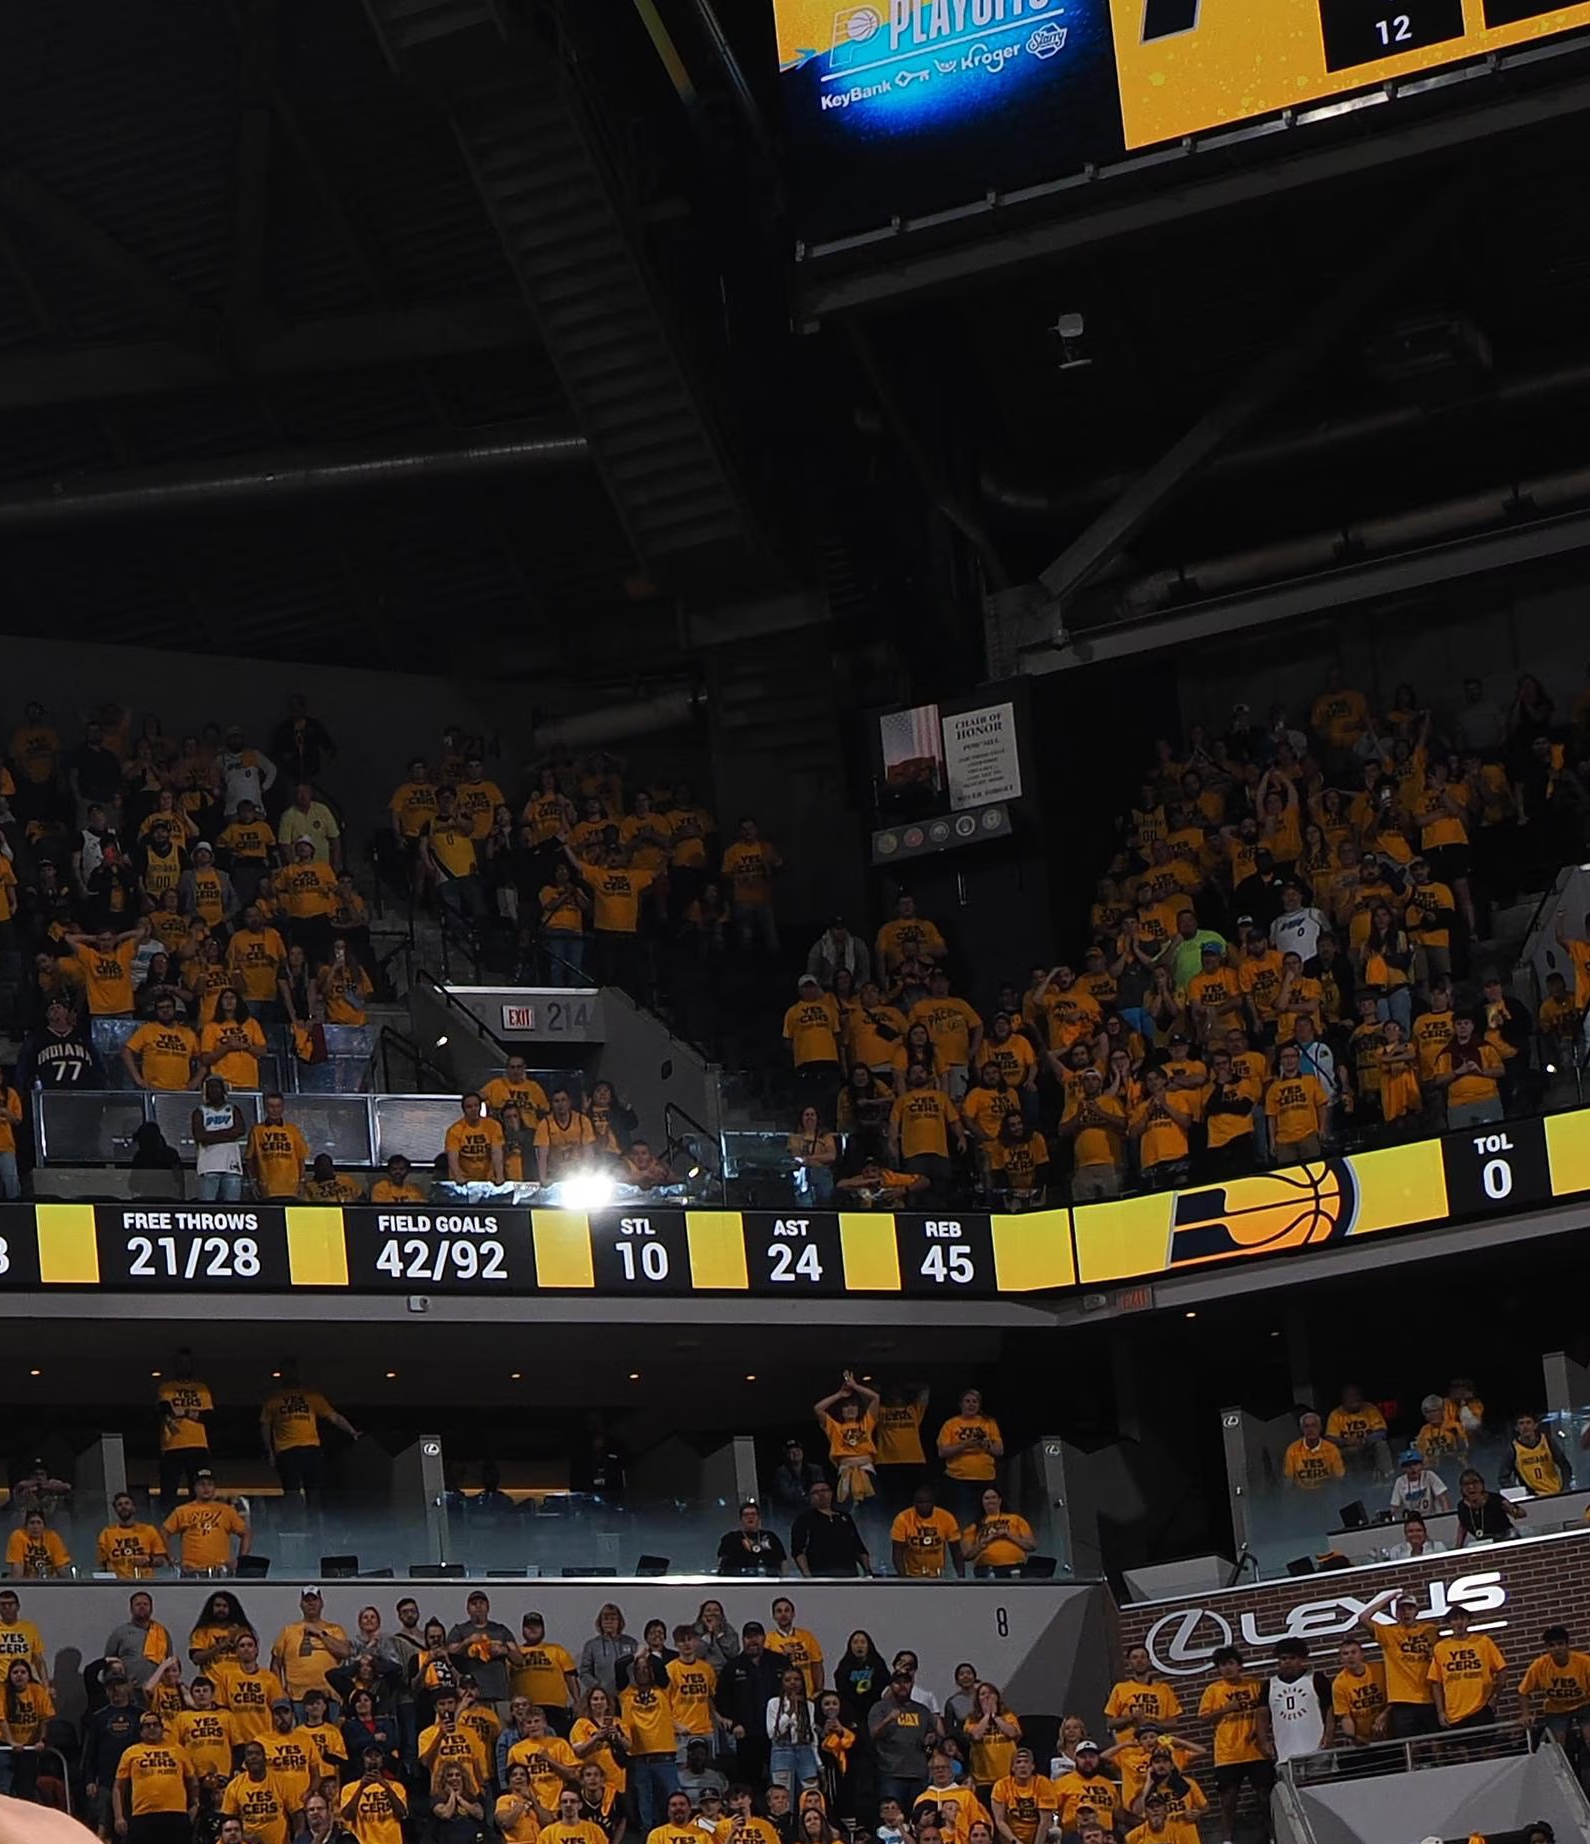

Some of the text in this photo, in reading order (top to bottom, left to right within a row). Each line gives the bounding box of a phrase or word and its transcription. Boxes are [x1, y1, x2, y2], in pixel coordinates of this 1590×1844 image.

[1375, 17, 1412, 46] 12
[821, 80, 892, 110] KeyBank
[961, 43, 1020, 73] Kroger
[956, 723, 1003, 740] HONOR
[508, 1007, 532, 1027] EXIT
[547, 1002, 588, 1031] 214
[53, 1062, 81, 1081] 77
[1474, 1133, 1513, 1155] TOL
[1483, 1159, 1513, 1199] 0
[123, 1212, 258, 1231] FREE THROWS
[378, 1216, 498, 1234] FIELD GOALS
[620, 1218, 655, 1236] STL
[773, 1220, 809, 1237] AST
[925, 1221, 962, 1239] REB
[128, 1237, 261, 1278] 21/28
[376, 1240, 508, 1281] 42/92
[616, 1242, 668, 1281] 10
[767, 1243, 822, 1283] 24
[921, 1245, 974, 1284] 45
[997, 1607, 1009, 1638] 8
